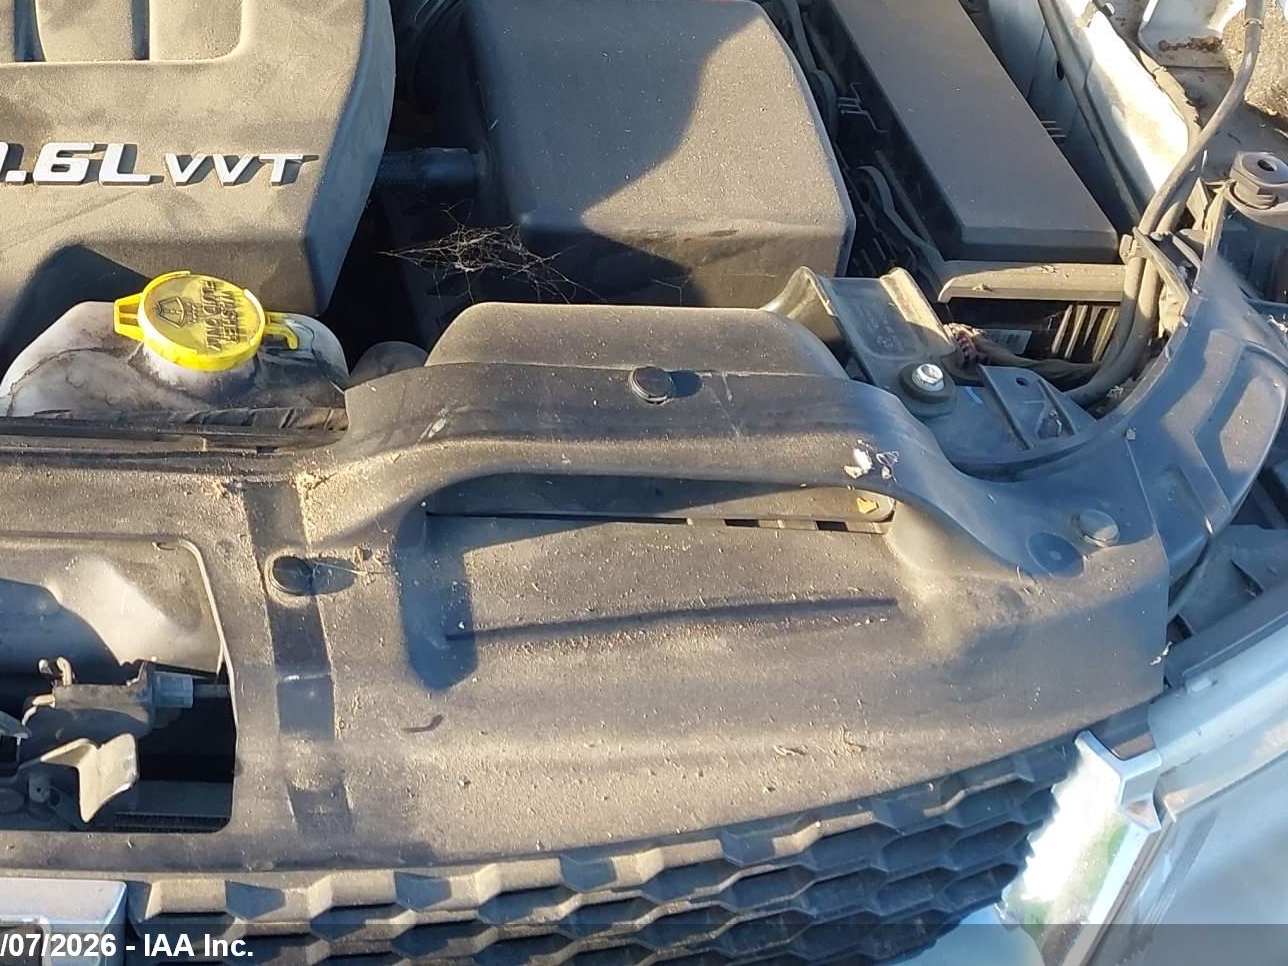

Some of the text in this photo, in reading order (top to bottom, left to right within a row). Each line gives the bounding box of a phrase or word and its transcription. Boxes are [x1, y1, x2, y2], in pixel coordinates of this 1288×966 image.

[165, 153, 305, 186] VVT
[219, 290, 240, 343] WASHER
[204, 318, 221, 351] ONLY
